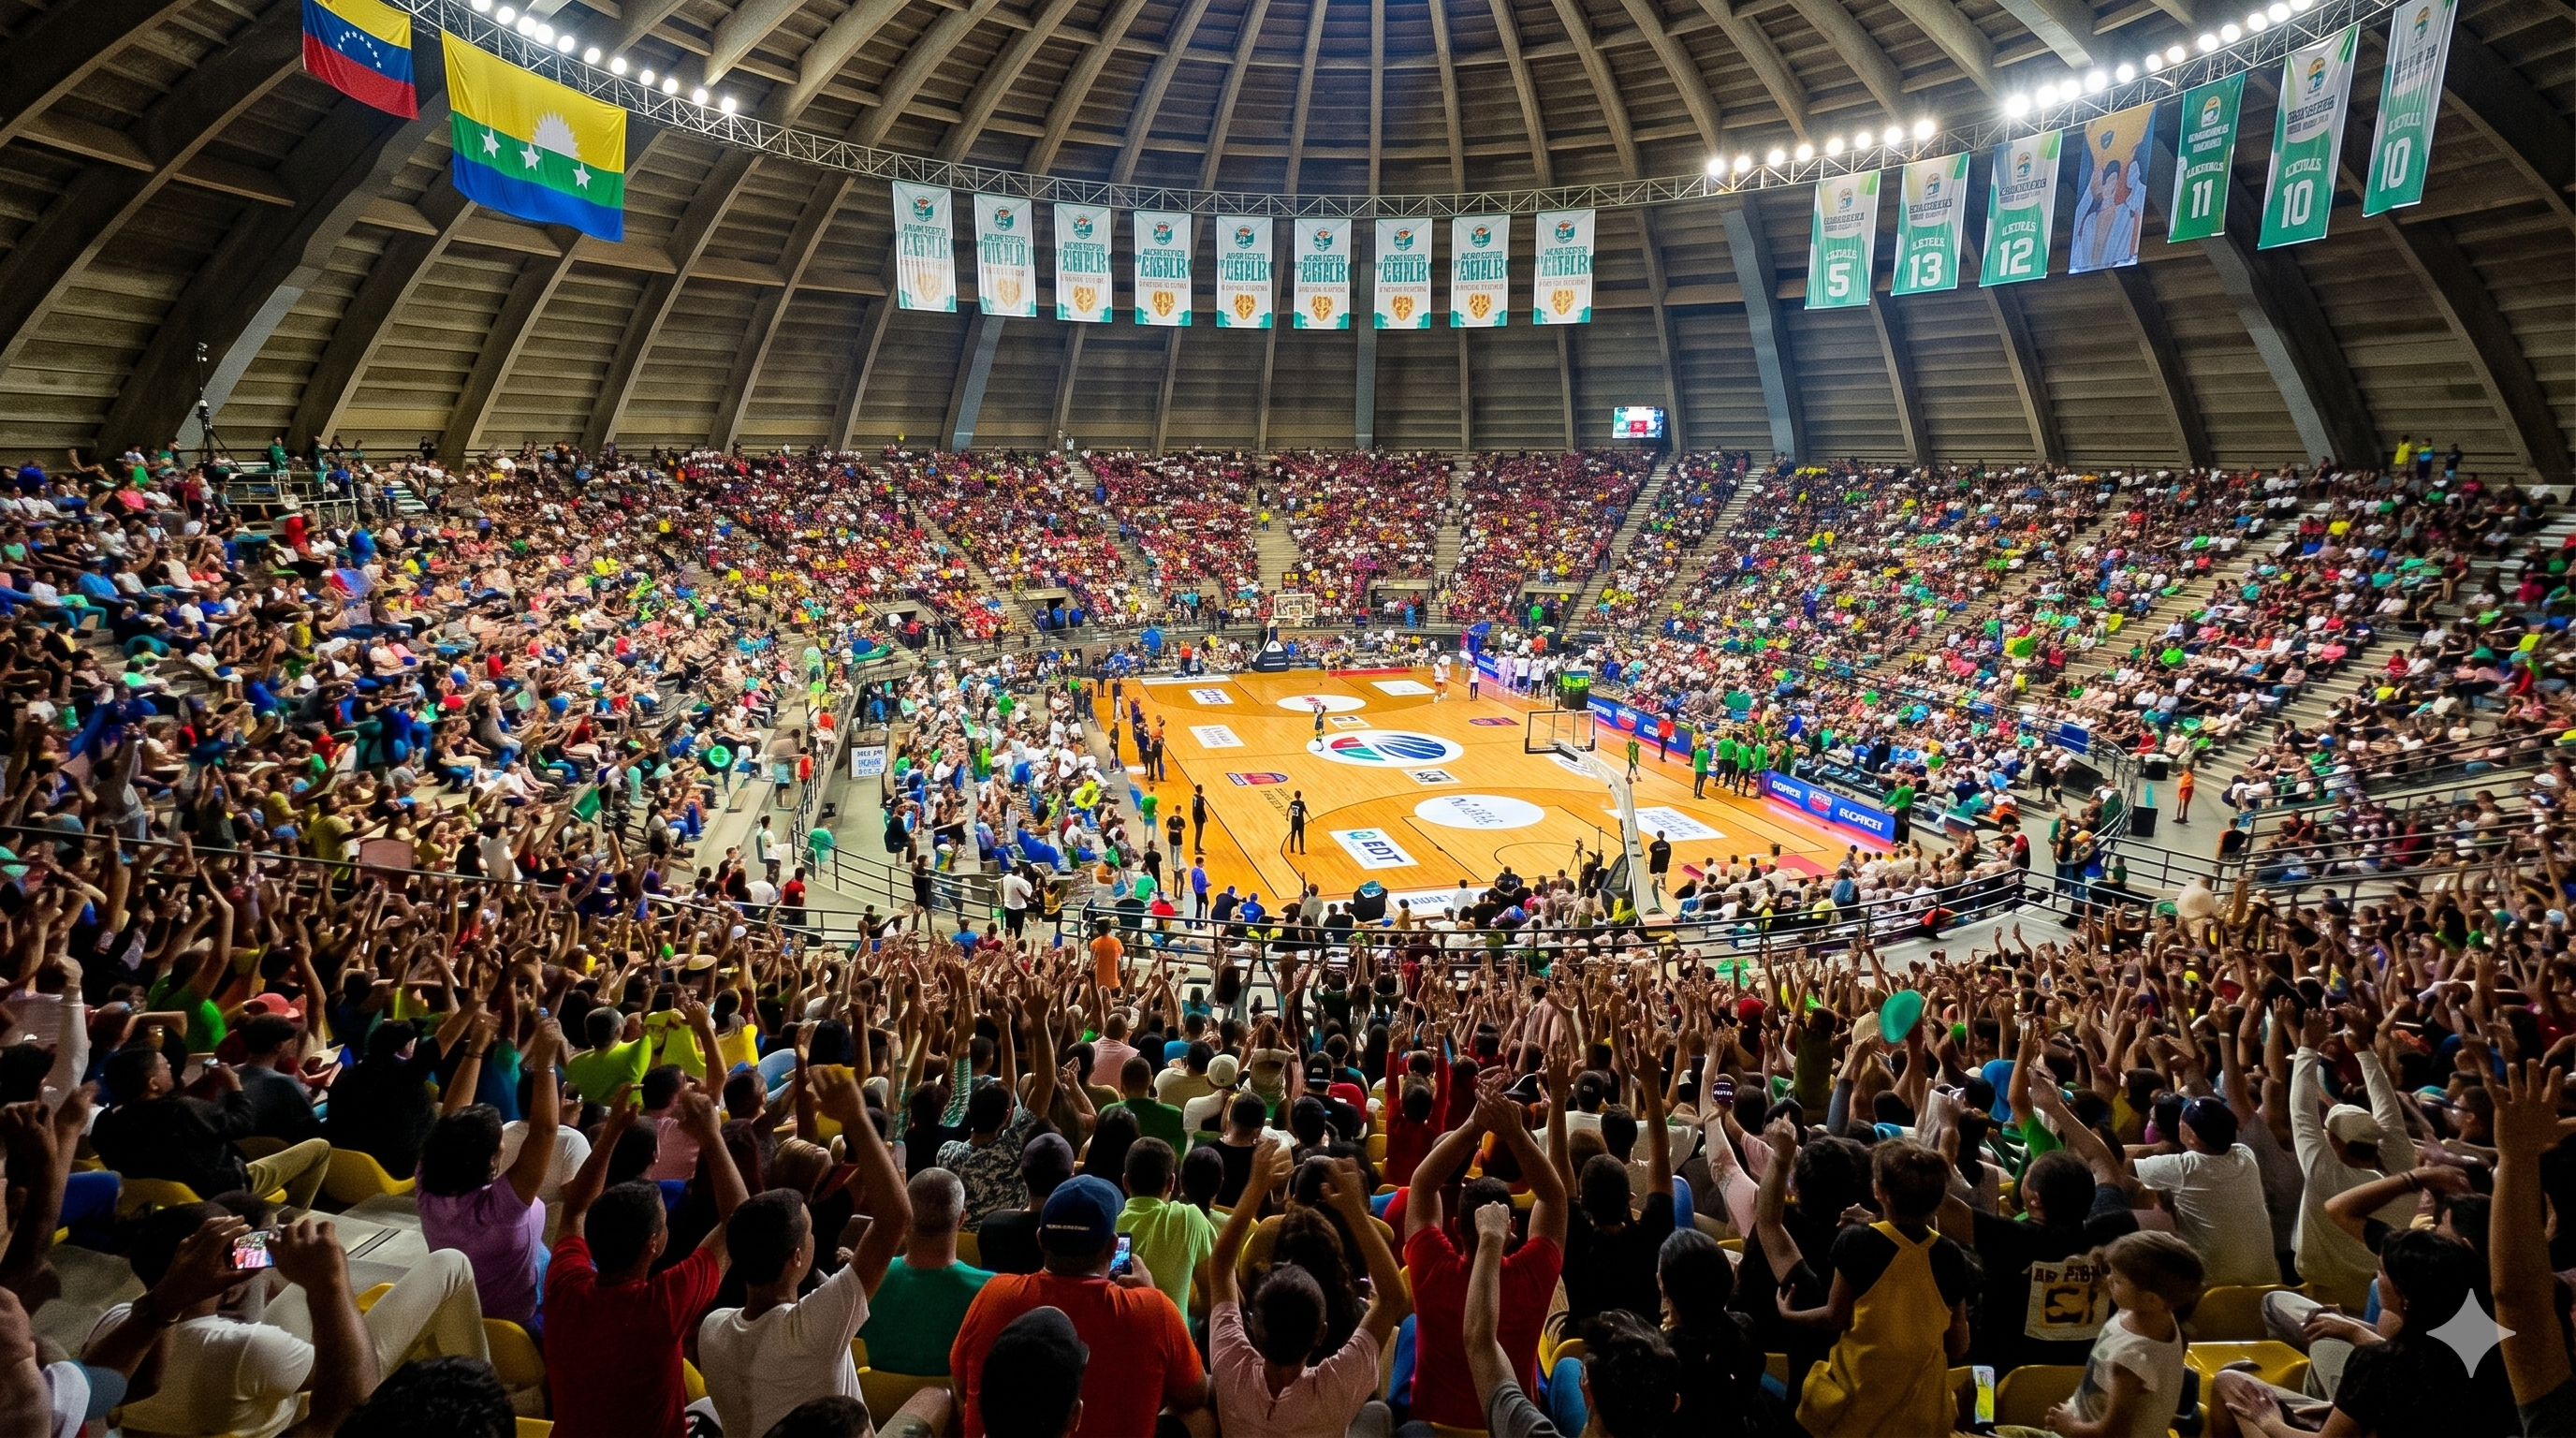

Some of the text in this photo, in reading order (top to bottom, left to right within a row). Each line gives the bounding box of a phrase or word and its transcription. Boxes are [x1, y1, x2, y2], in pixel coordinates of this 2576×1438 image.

[2379, 136, 2411, 193] 10
[2190, 179, 2214, 219] 11
[2281, 179, 2314, 228] 10
[1910, 252, 1943, 288] 13
[1999, 237, 2034, 277] 12
[1828, 262, 1852, 298] 5
[1361, 841, 1405, 863] EDT
